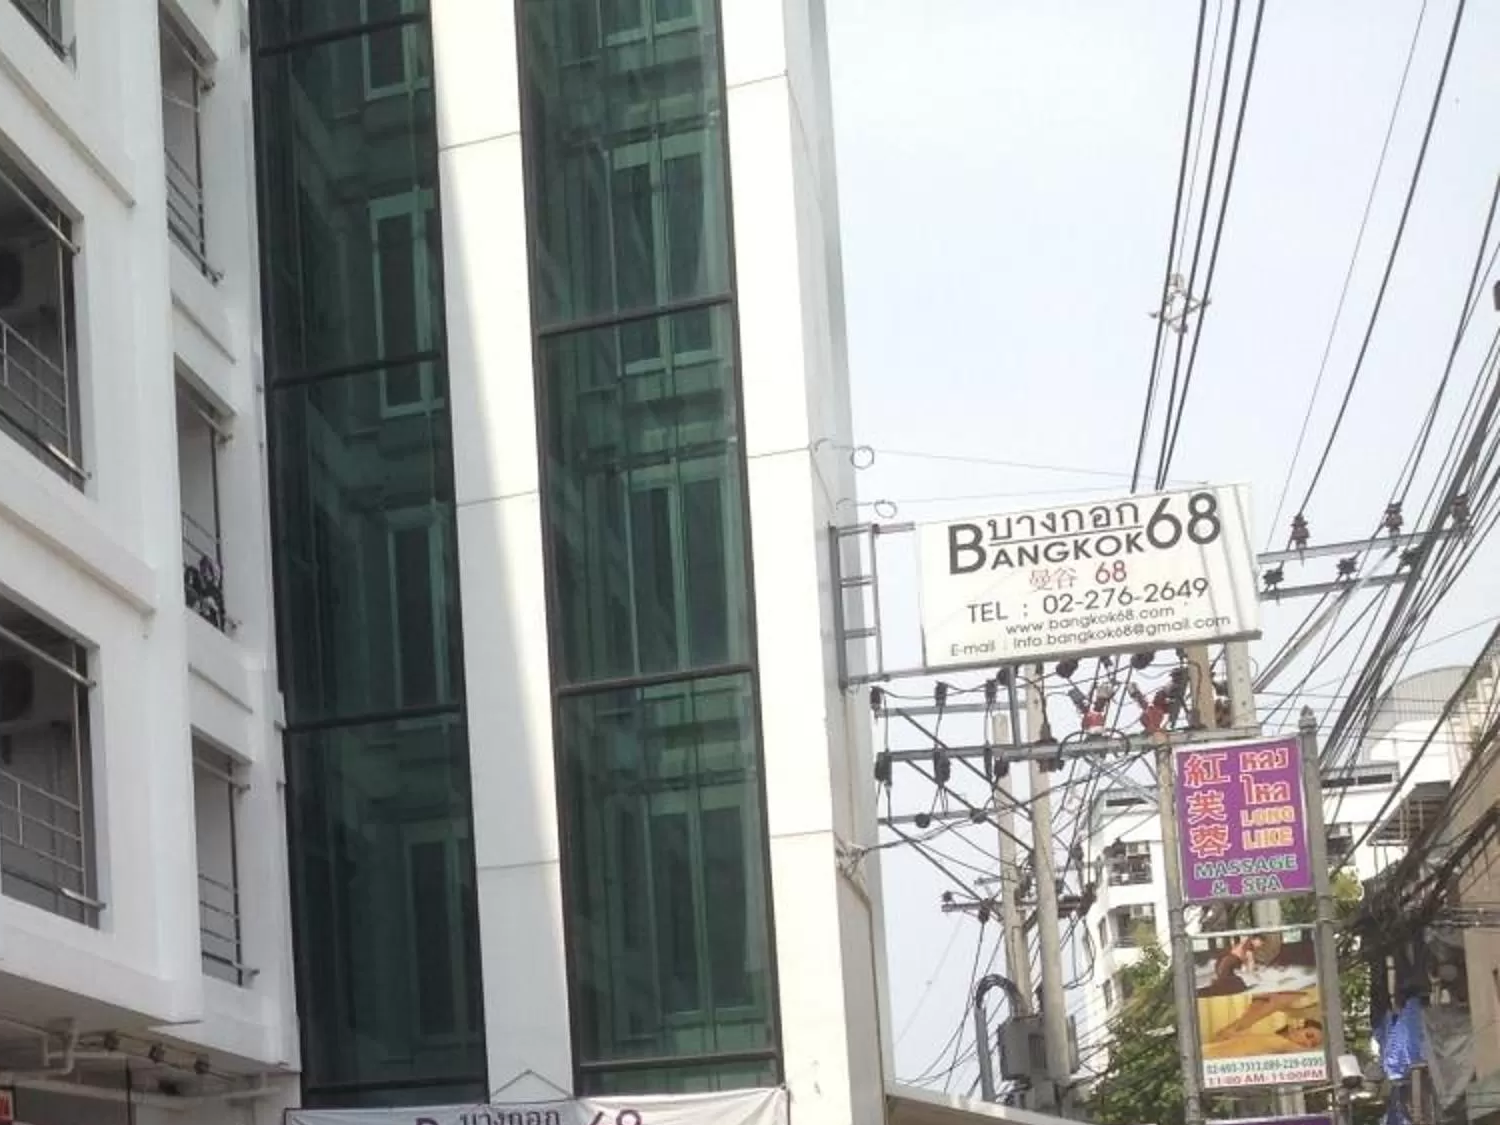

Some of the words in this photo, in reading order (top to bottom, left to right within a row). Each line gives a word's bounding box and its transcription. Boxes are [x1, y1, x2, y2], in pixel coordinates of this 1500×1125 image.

[950, 520, 1146, 575] BANGKOK
[1146, 491, 1222, 549] 68
[987, 501, 1140, 541] บางกอก
[1029, 566, 1077, 591] 曼谷
[1095, 559, 1128, 585] 68
[967, 601, 1009, 625] TEL
[1042, 576, 1210, 616] 02-276-2649
[1005, 604, 1175, 636] www.bangkok68.com
[1184, 752, 1232, 860] 紅芙蓉
[1193, 853, 1299, 881] MASSAGE
[1211, 879, 1231, 898] &
[1241, 874, 1285, 895] SPA
